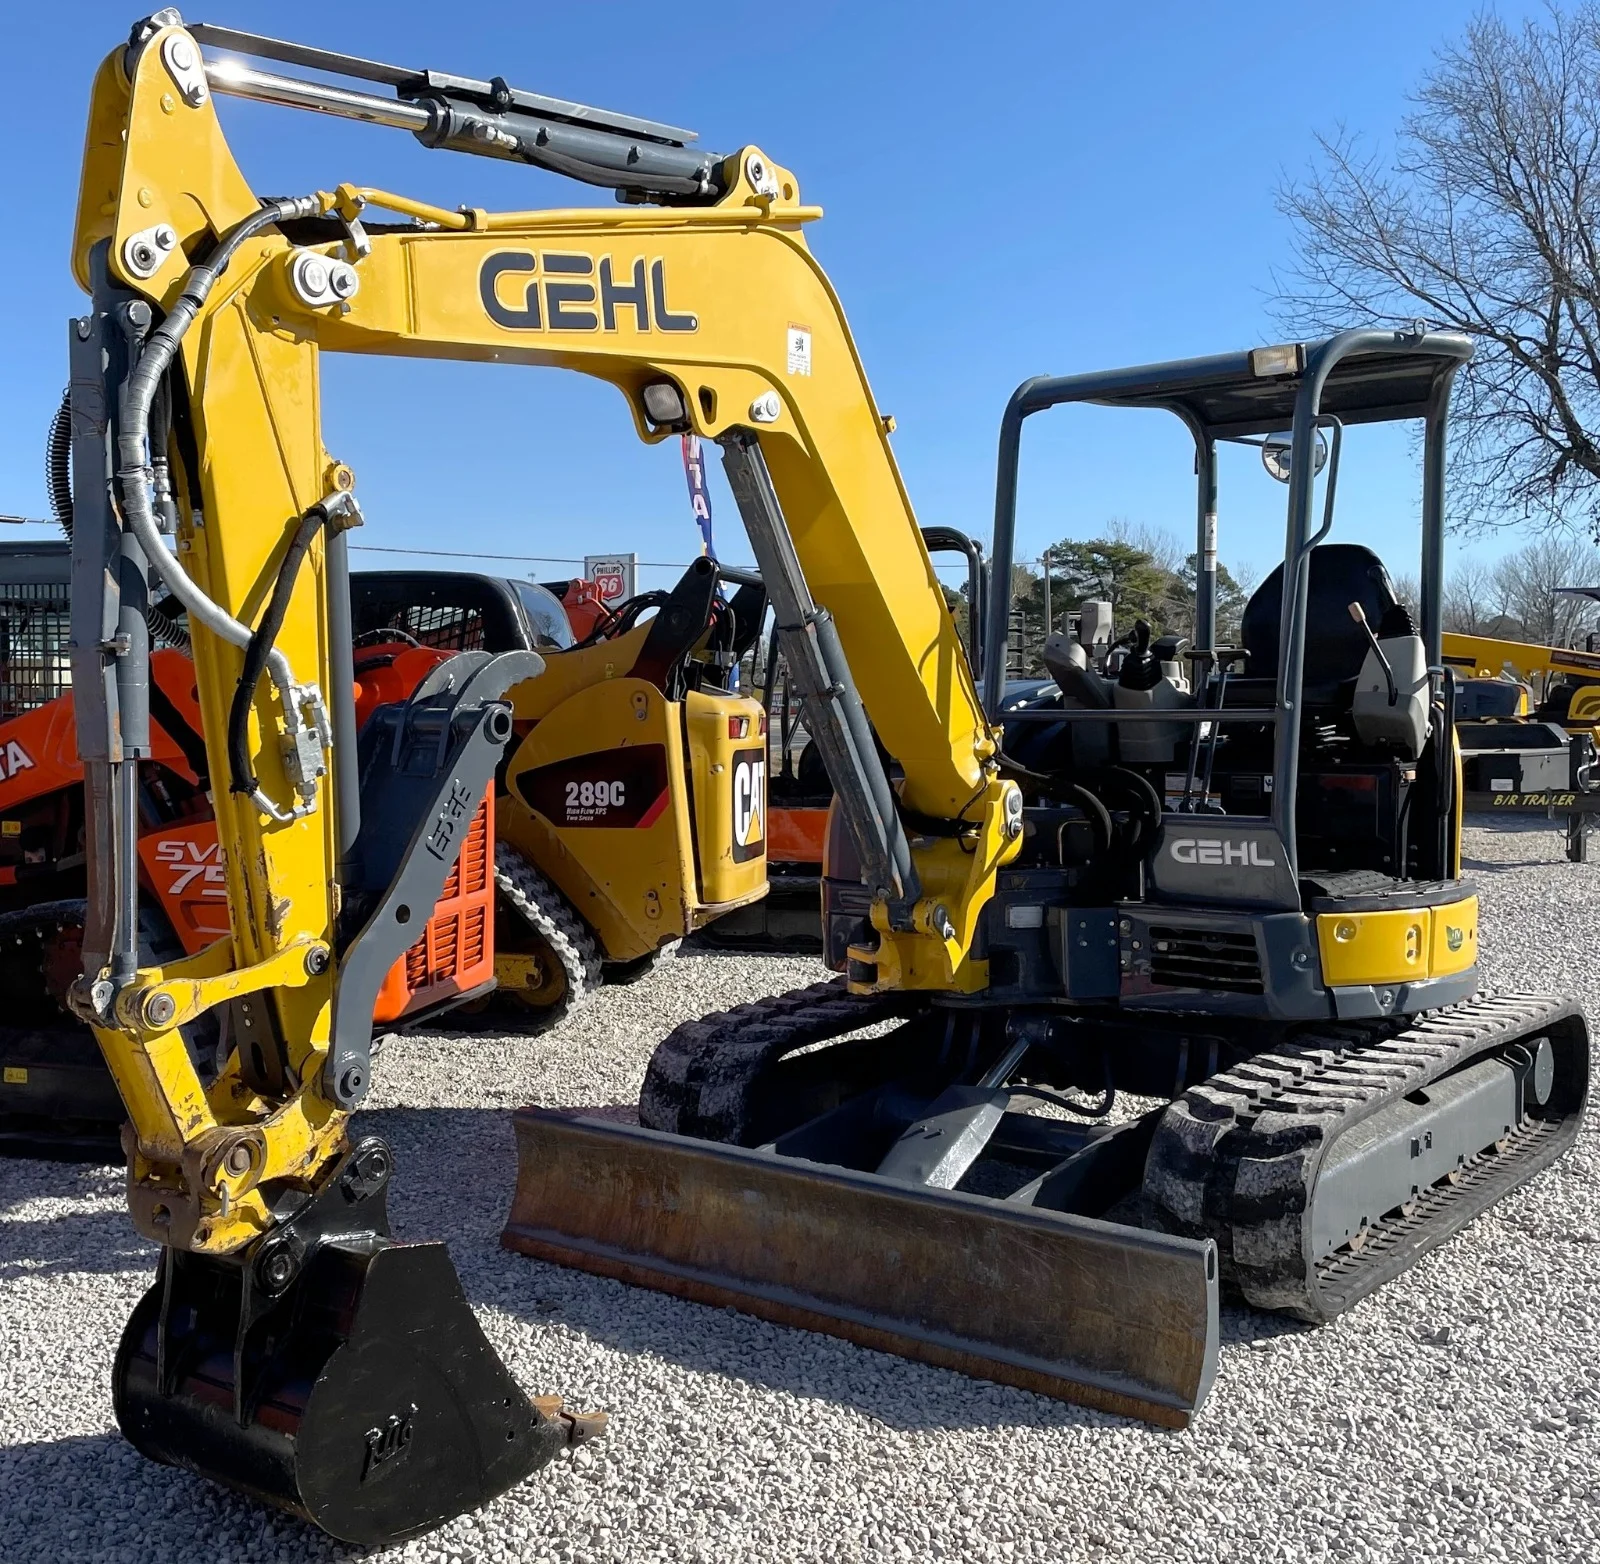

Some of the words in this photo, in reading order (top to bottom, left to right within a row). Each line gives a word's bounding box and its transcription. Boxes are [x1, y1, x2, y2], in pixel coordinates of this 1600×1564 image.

[478, 249, 699, 332] GEHL
[597, 566, 620, 574] PHILLIPS
[599, 578, 618, 592] 66
[565, 780, 625, 807] 289C
[734, 761, 765, 847] CAT
[1493, 794, 1519, 806] B/R
[1170, 839, 1276, 867] GEHL
